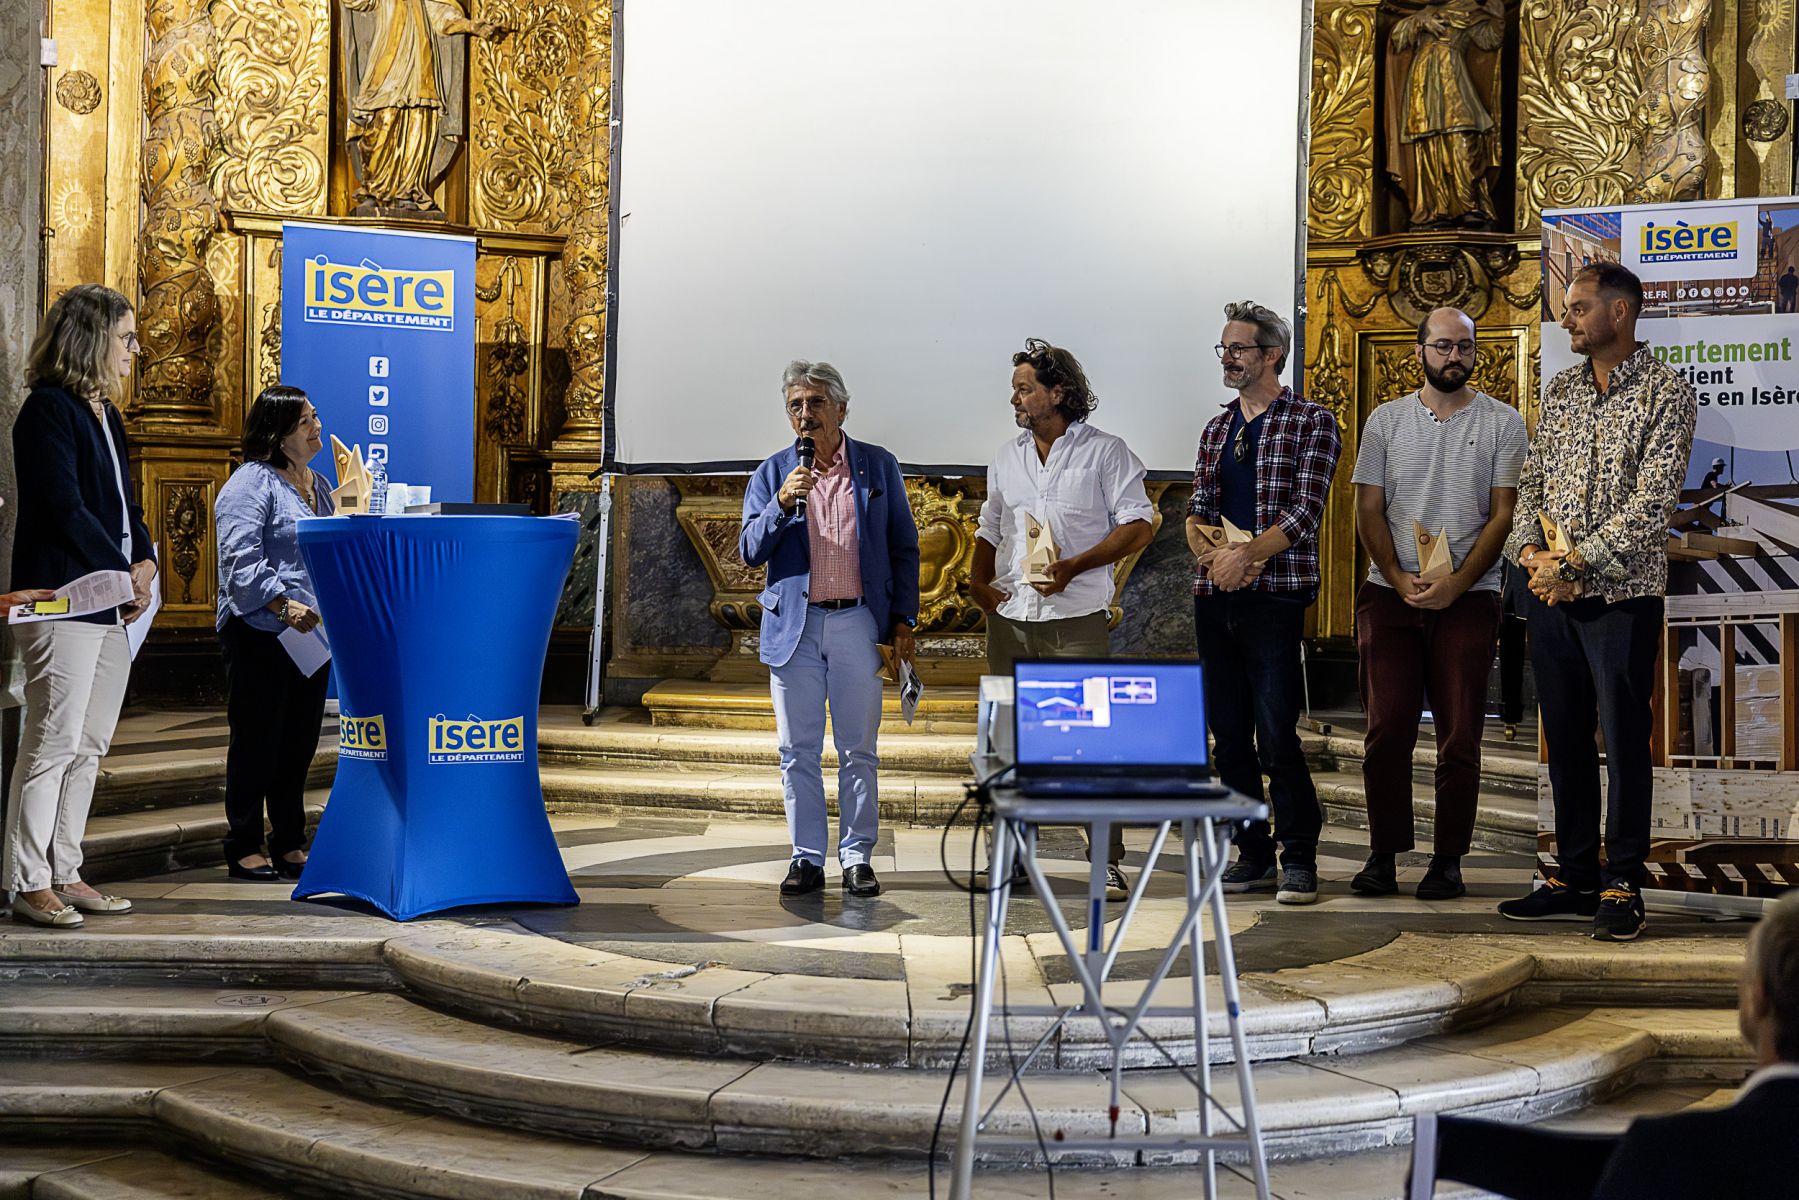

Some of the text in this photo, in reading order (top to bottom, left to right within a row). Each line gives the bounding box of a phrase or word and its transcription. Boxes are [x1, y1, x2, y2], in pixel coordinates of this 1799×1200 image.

[1646, 220, 1732, 250] isère
[1656, 252, 1737, 261] DÉPARTEMENT
[315, 255, 445, 310] isère
[309, 309, 451, 327] LE DÉPARTEMENT
[1692, 385, 1799, 406] s en Isèr
[435, 714, 519, 750] isère
[447, 753, 523, 761] DÉPARTEMENT
